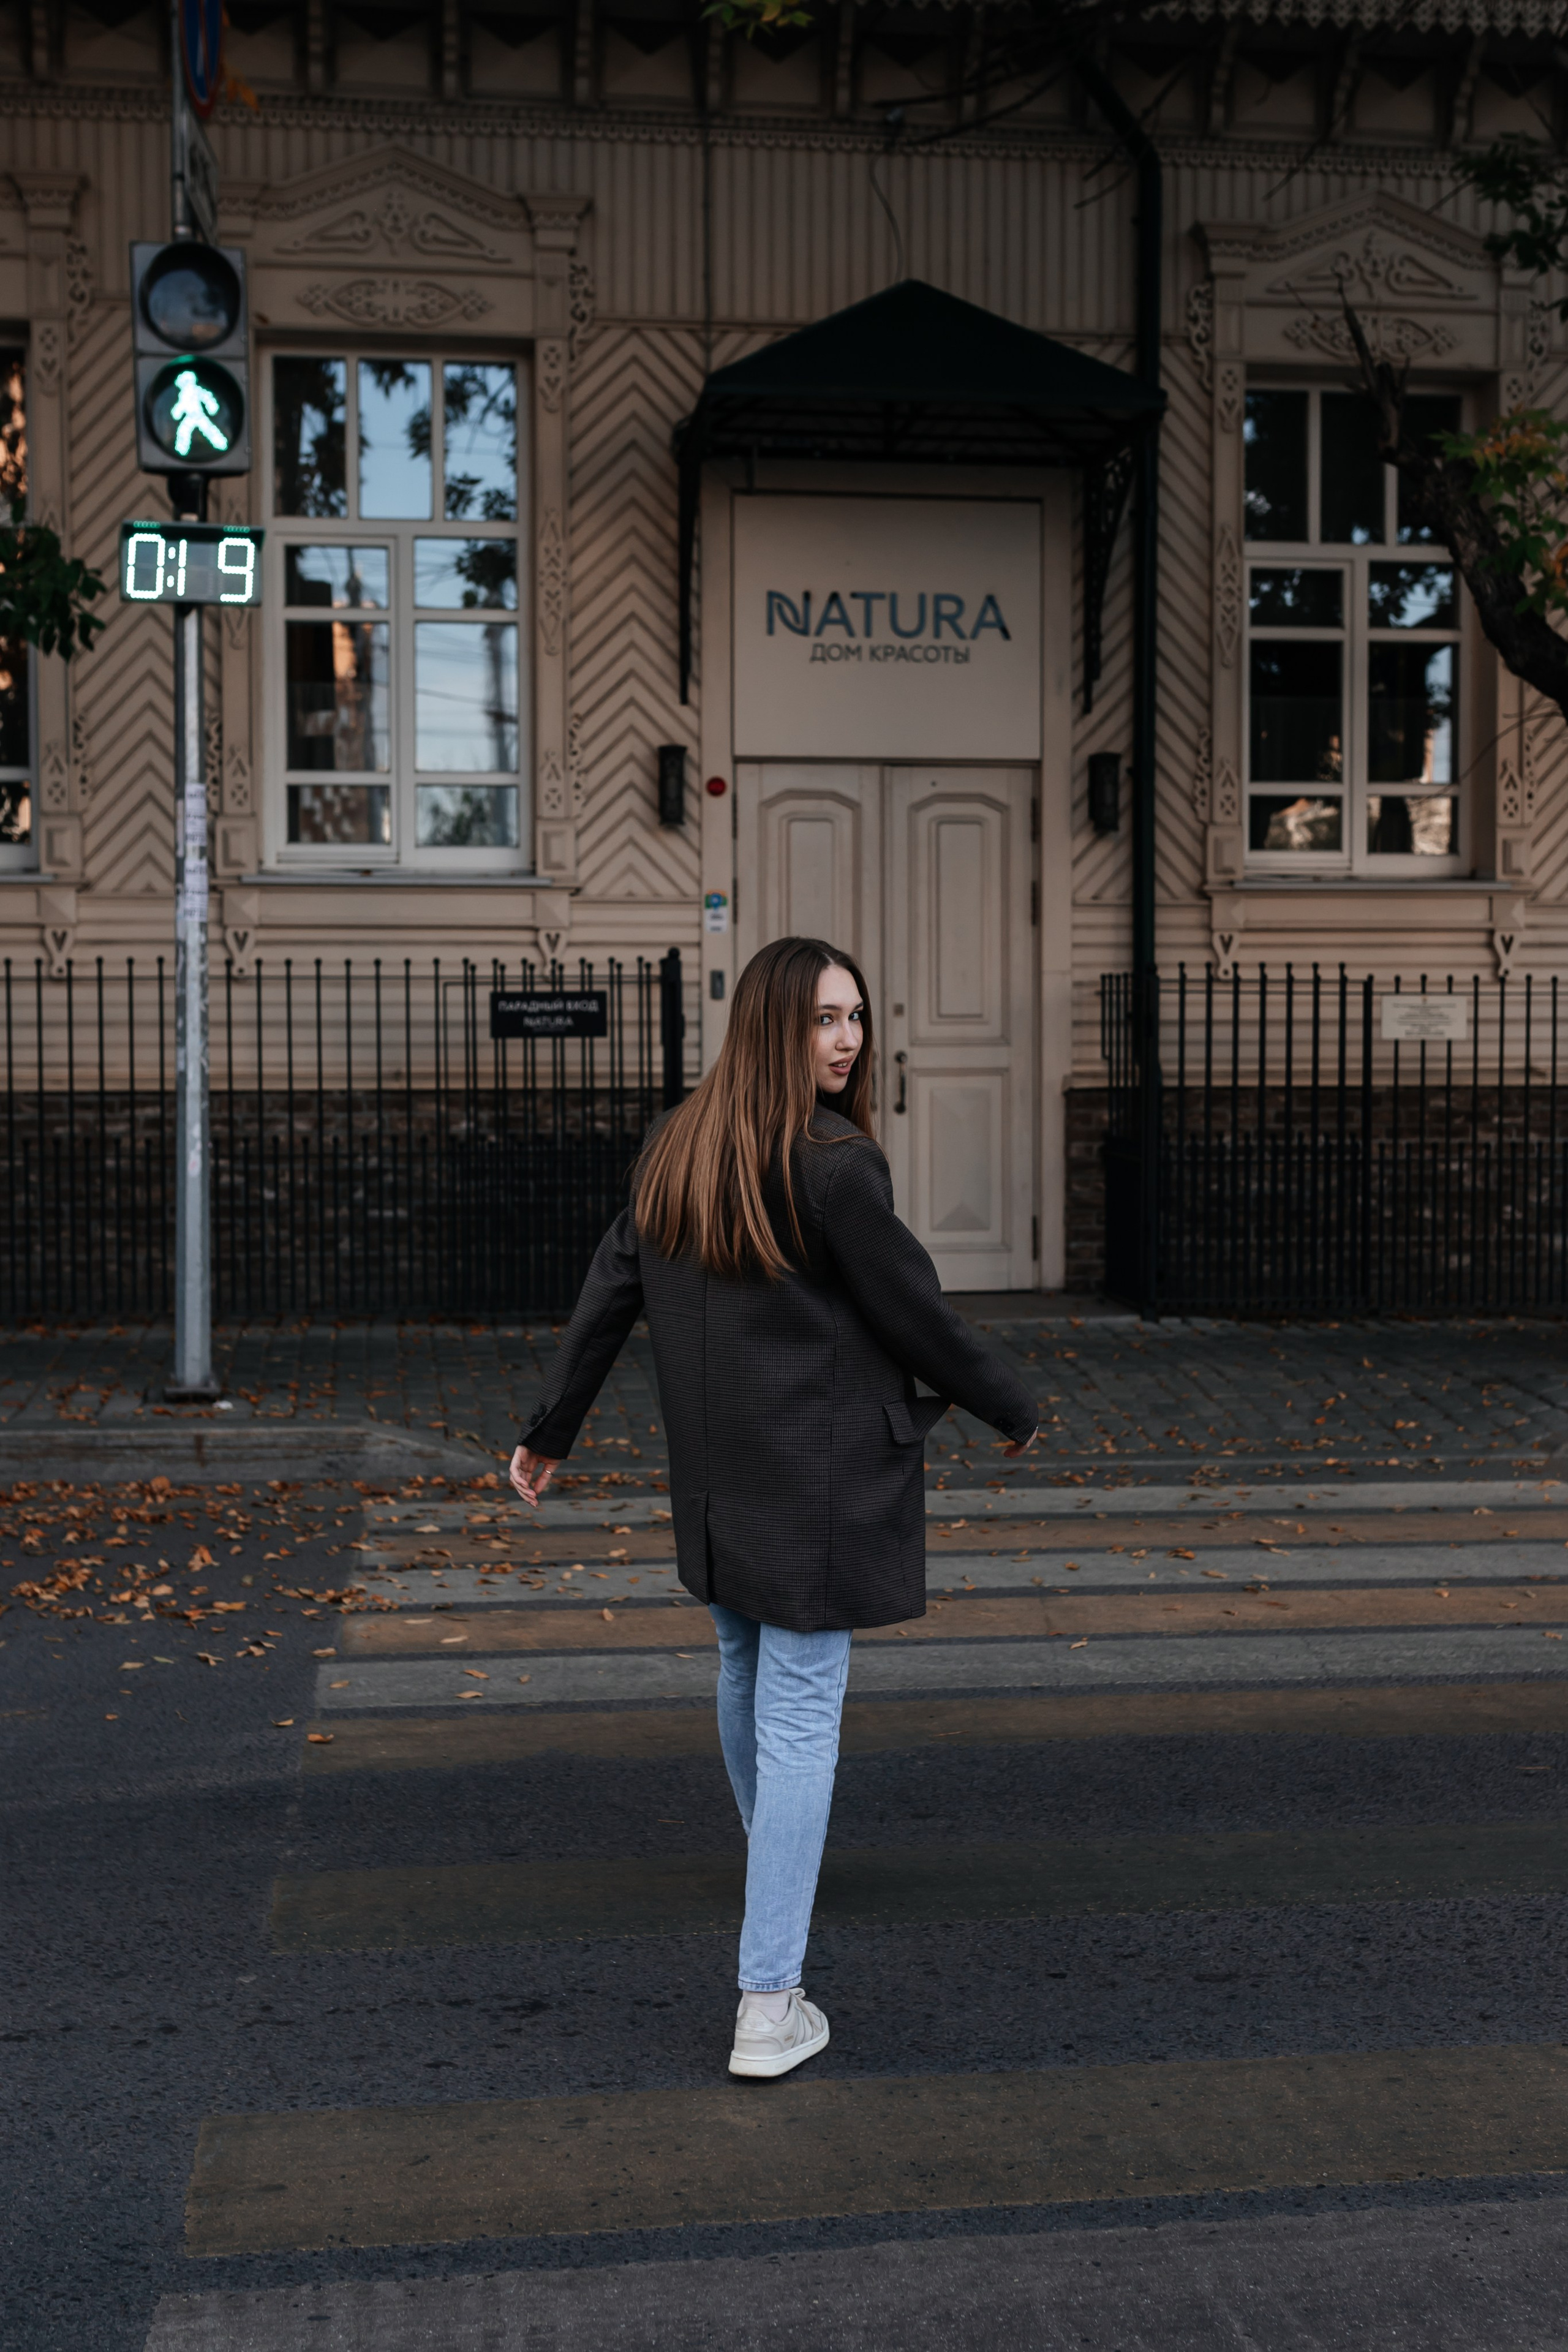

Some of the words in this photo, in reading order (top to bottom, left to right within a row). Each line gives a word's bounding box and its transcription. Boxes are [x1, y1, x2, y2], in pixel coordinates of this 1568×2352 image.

[766, 590, 1012, 641] NATURA
[810, 643, 862, 663] ДОМ
[869, 644, 971, 664] КРАСОТЫ
[523, 1016, 574, 1028] NATURA
